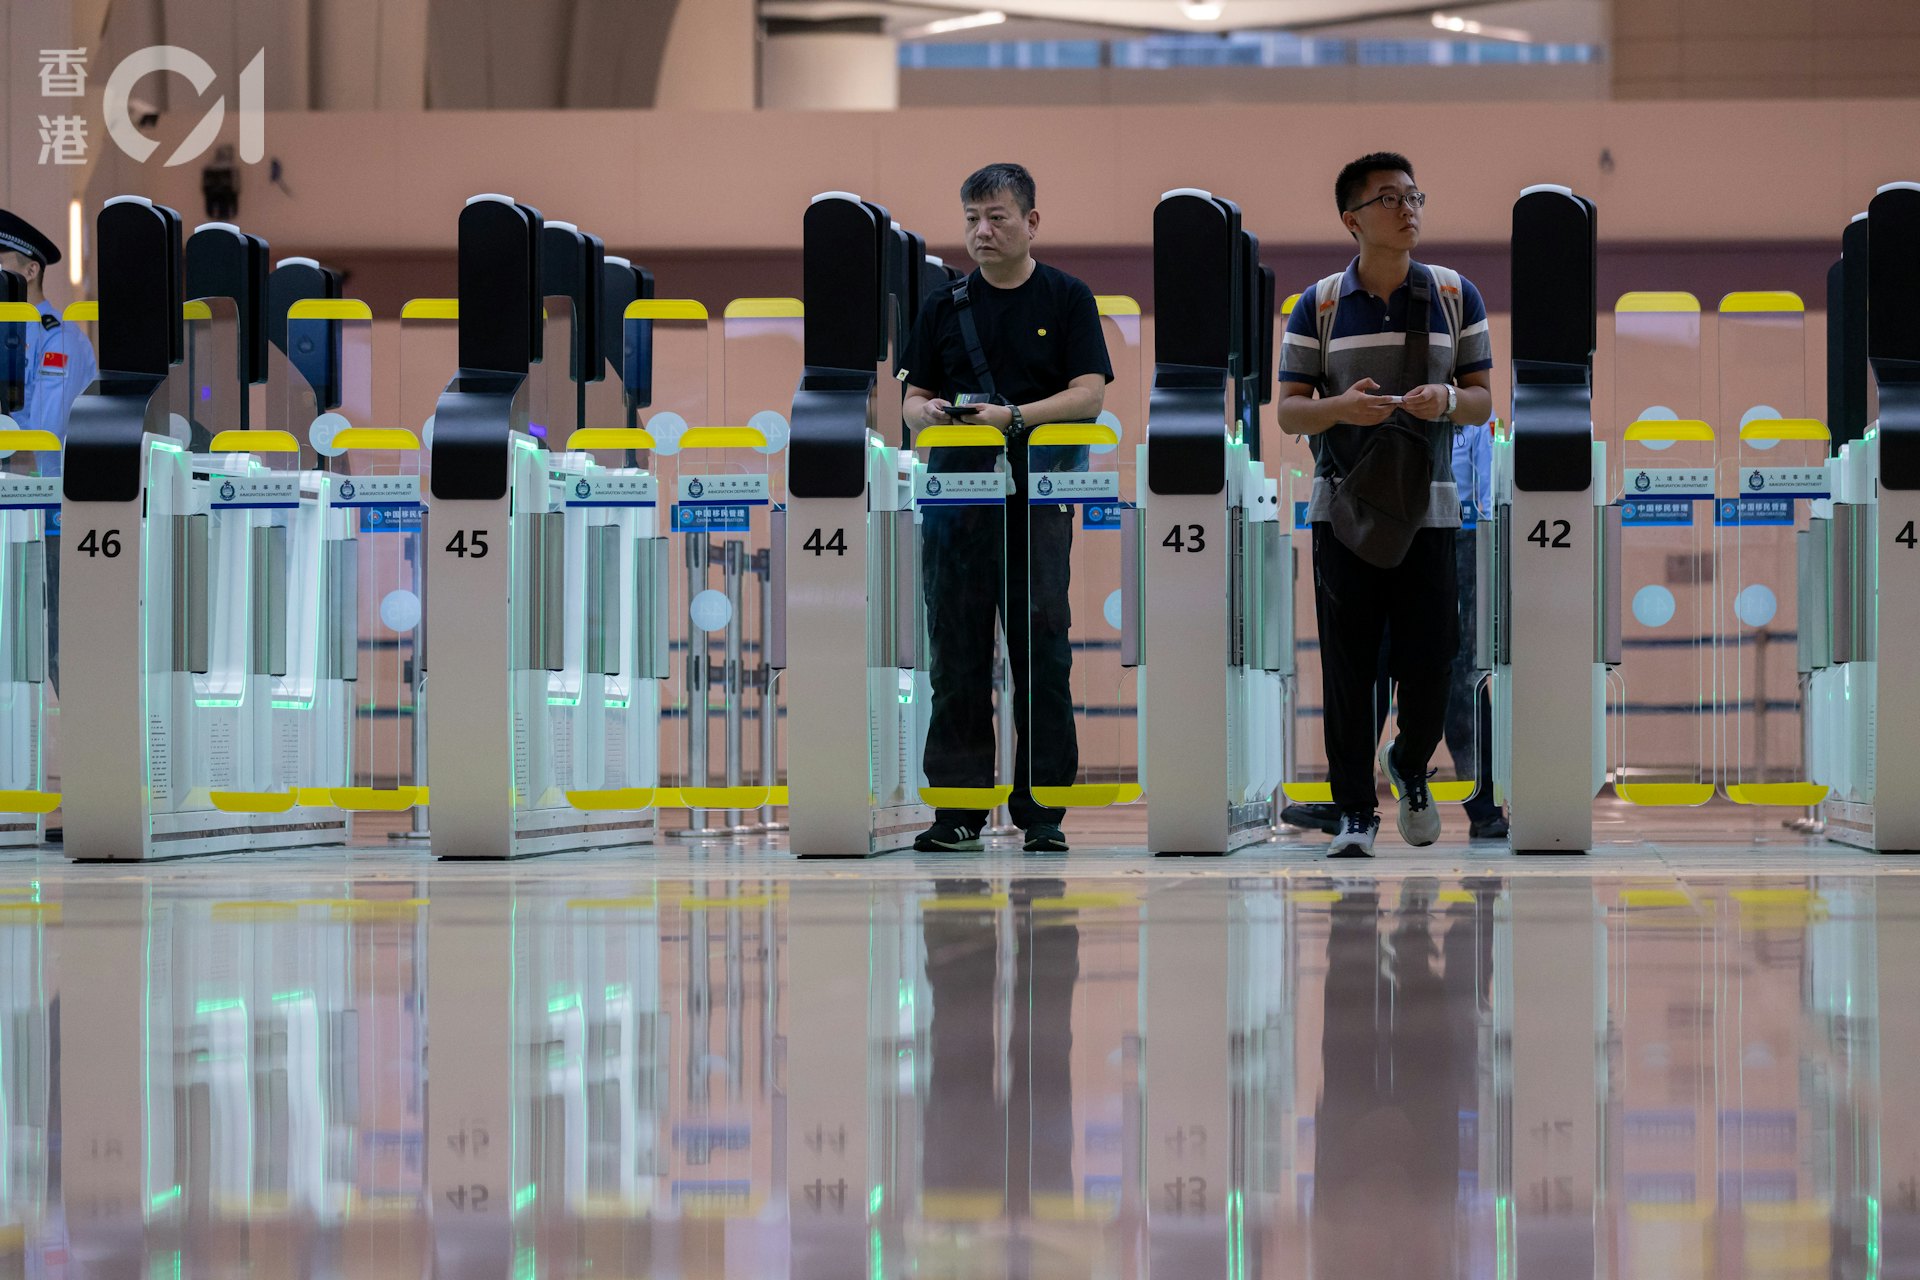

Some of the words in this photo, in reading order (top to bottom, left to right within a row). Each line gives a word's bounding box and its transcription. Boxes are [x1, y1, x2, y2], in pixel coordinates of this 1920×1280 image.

[695, 509, 745, 517] 中国移民管理
[1637, 504, 1688, 512] 中国移民管理
[1737, 503, 1787, 511] 中国移民管理
[77, 529, 122, 558] 46
[445, 529, 489, 558] 45
[803, 528, 848, 556] 44
[1162, 524, 1206, 553] 43
[1527, 520, 1571, 549] 42
[1895, 520, 1918, 549] 4
